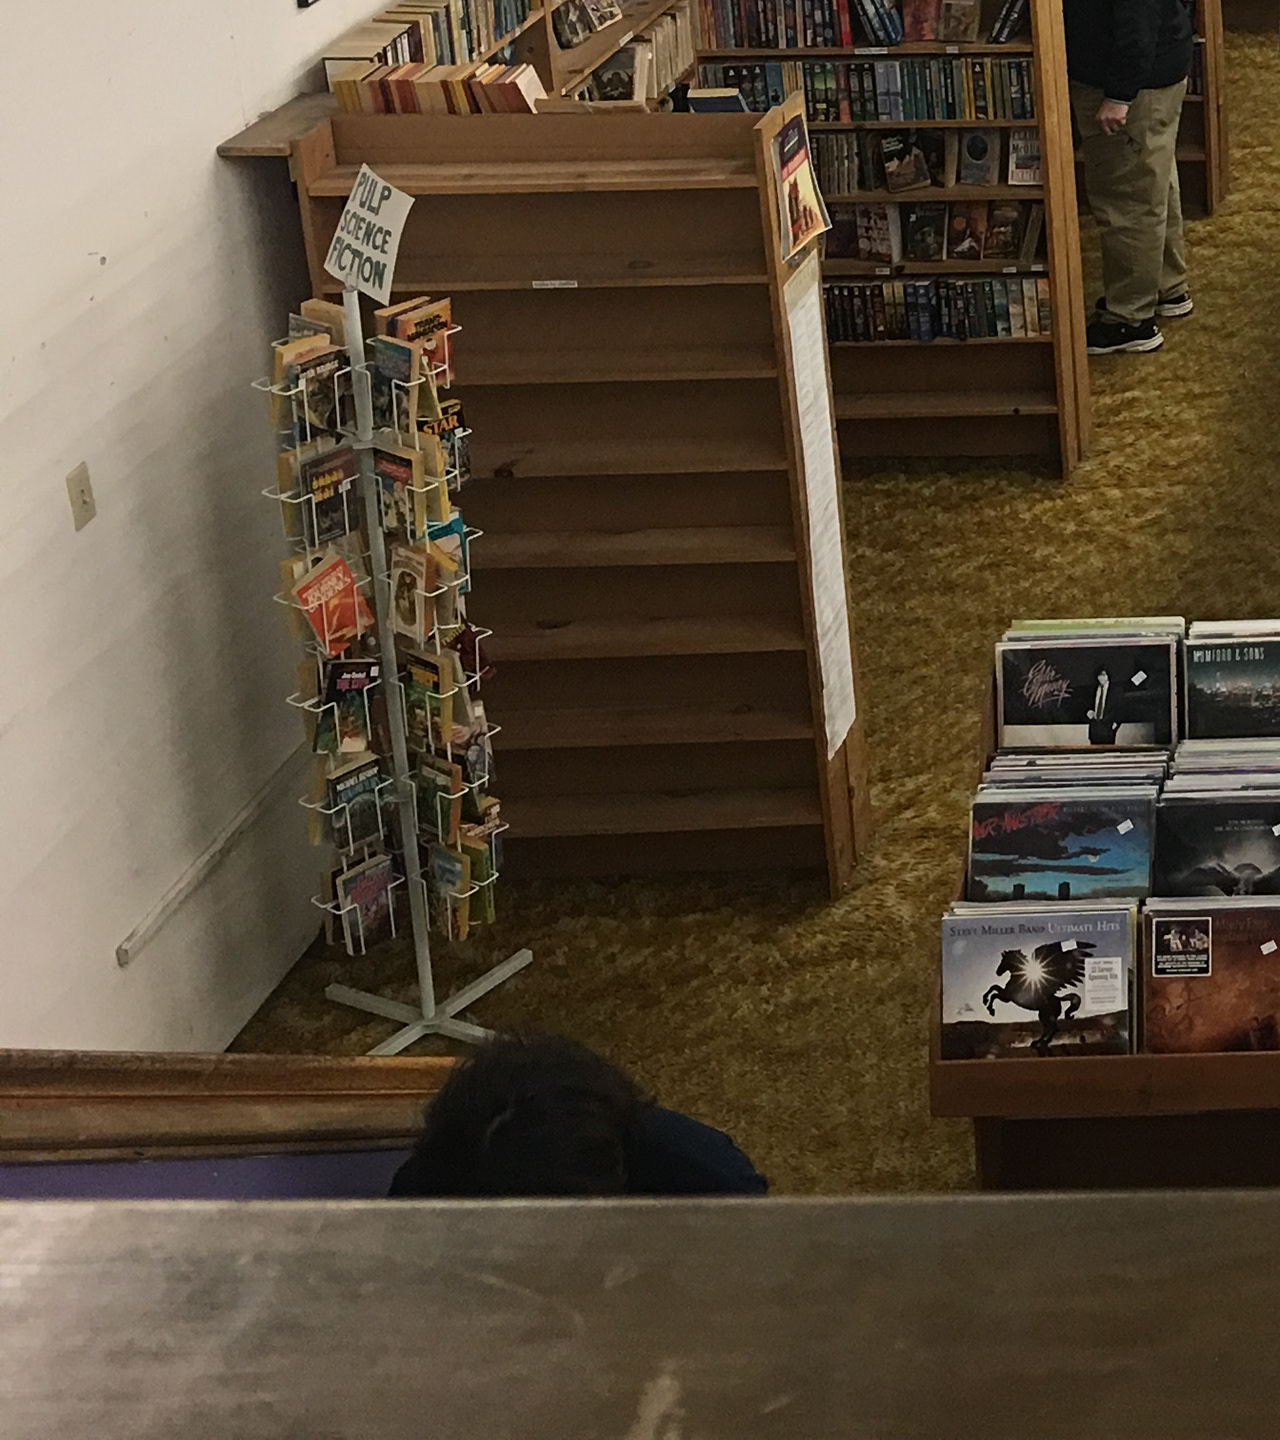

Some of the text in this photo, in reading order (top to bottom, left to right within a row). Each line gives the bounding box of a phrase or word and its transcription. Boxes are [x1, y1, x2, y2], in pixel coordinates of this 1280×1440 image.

[352, 172, 392, 216] PULP
[340, 208, 392, 254] SCIENCE
[329, 236, 387, 291] FICTION
[423, 416, 460, 435] STAR
[1193, 648, 1233, 663] MUMFORD
[1244, 646, 1265, 661] SONS
